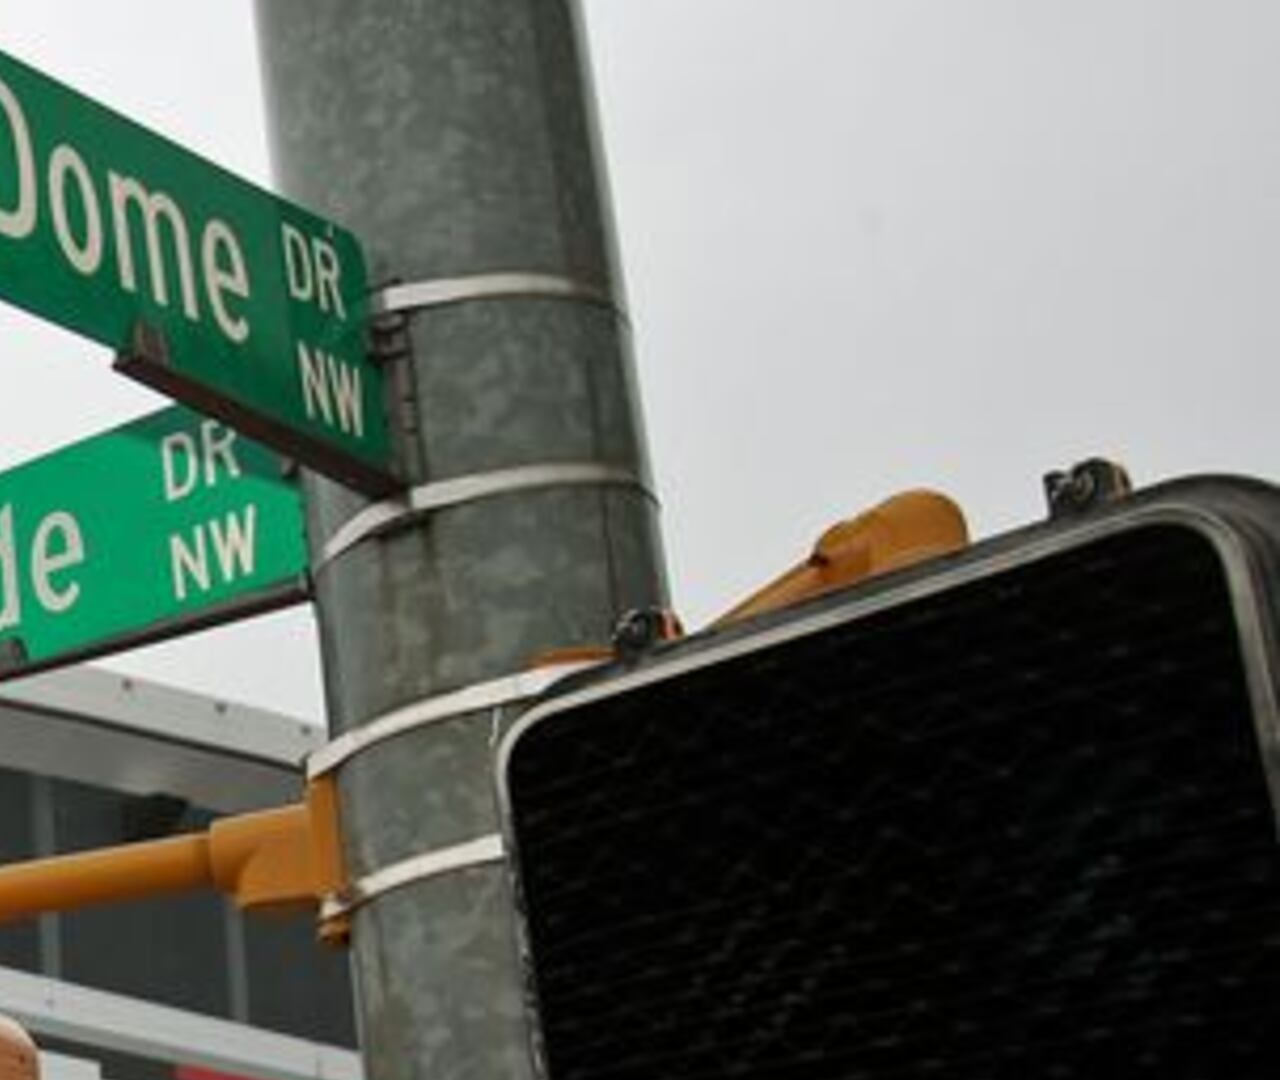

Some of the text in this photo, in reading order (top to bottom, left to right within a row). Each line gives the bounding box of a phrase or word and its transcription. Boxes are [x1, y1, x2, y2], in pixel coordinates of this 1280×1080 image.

[280, 222, 345, 319] DR
[298, 340, 363, 436] NW
[160, 420, 240, 501] DR
[170, 504, 257, 600] NW
